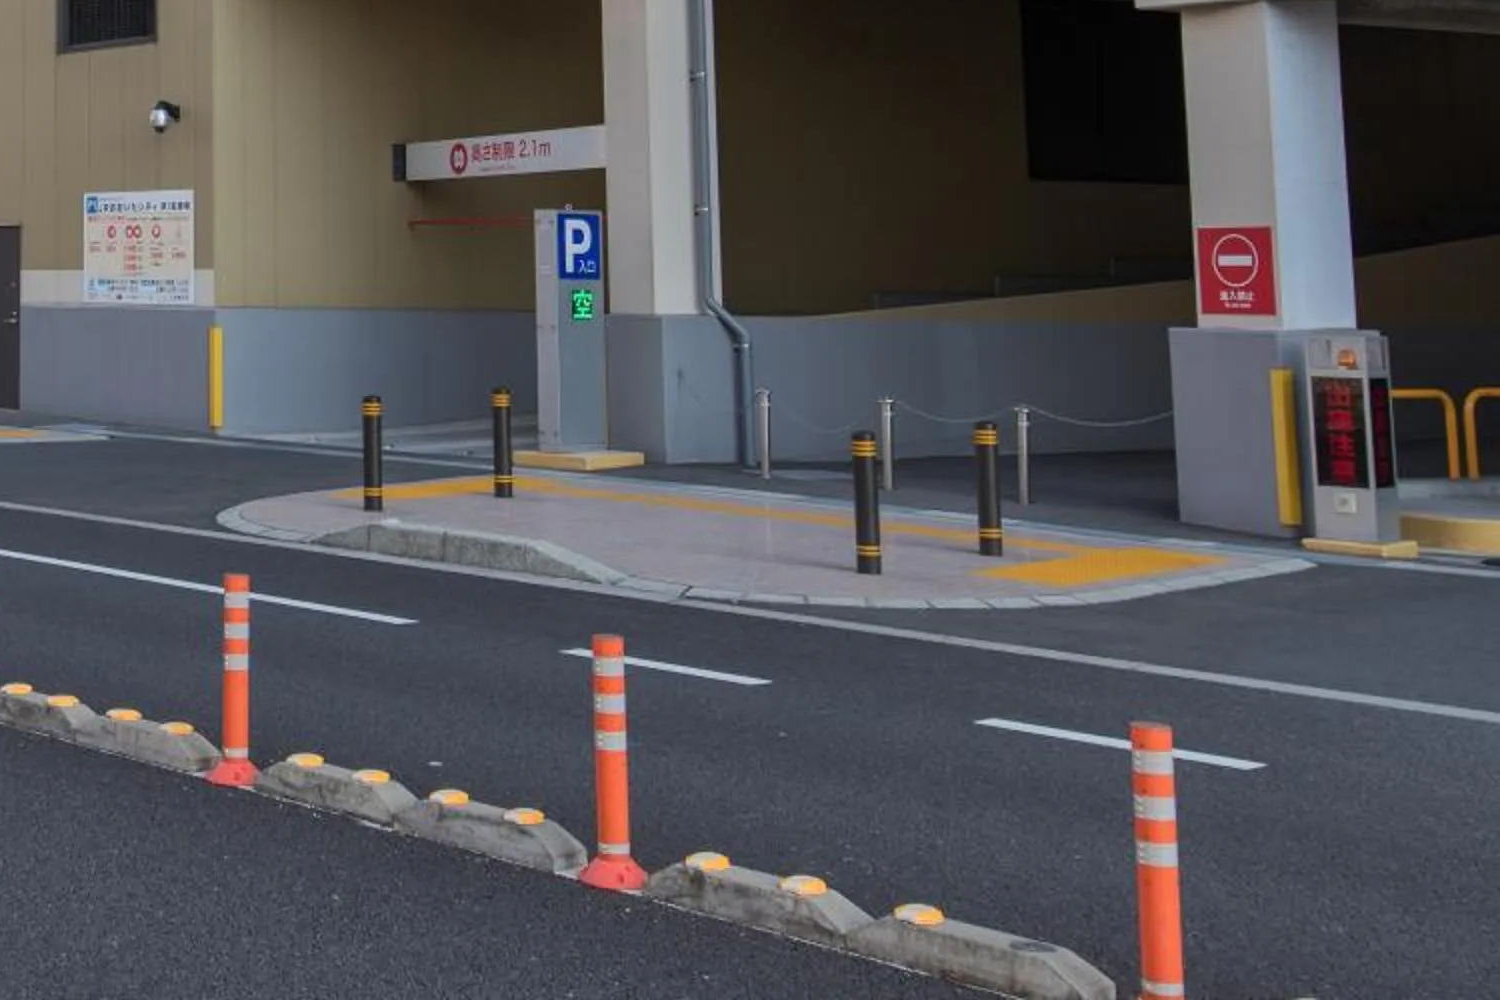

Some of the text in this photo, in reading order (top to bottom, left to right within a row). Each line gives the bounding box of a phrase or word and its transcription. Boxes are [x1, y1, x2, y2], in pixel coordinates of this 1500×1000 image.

[519, 138, 551, 158] 2.1m
[564, 219, 592, 273] P
[578, 259, 597, 273] 入口
[573, 288, 593, 319] 空
